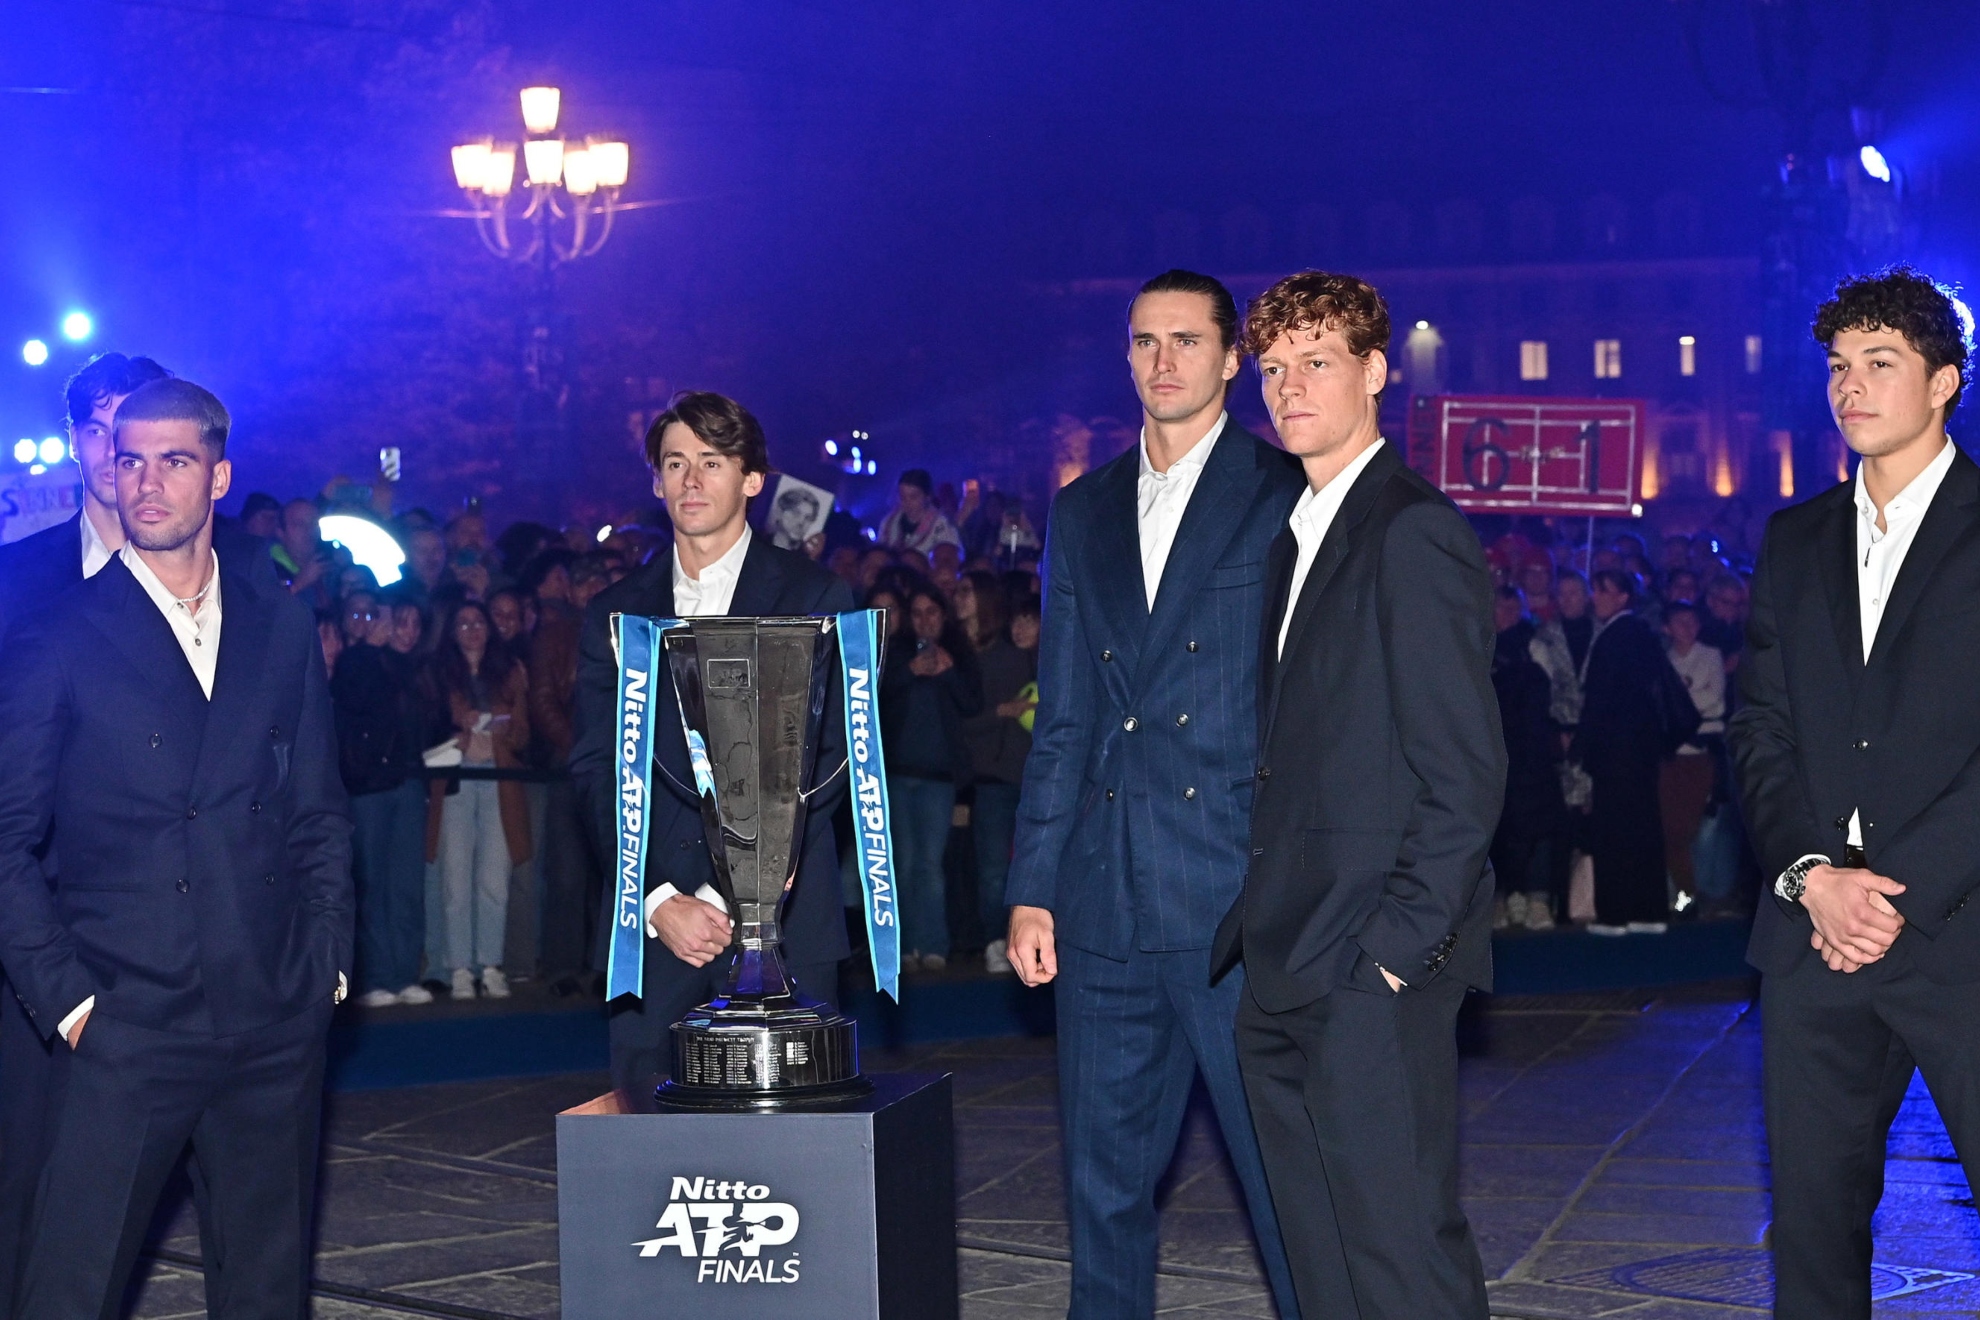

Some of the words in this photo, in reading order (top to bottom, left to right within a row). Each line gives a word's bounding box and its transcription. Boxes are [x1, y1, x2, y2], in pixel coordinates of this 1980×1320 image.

[1462, 417, 1510, 492] 6
[1577, 419, 1600, 494] 1
[622, 668, 648, 764] Nitto
[850, 667, 870, 763] Nitto
[622, 765, 643, 834] ATP
[857, 765, 884, 832] ATP
[620, 832, 641, 929] FINALS
[865, 832, 894, 927] FINALS
[669, 1176, 770, 1200] Nitto
[630, 1202, 800, 1257] ATP
[697, 1259, 800, 1283] FINALS
